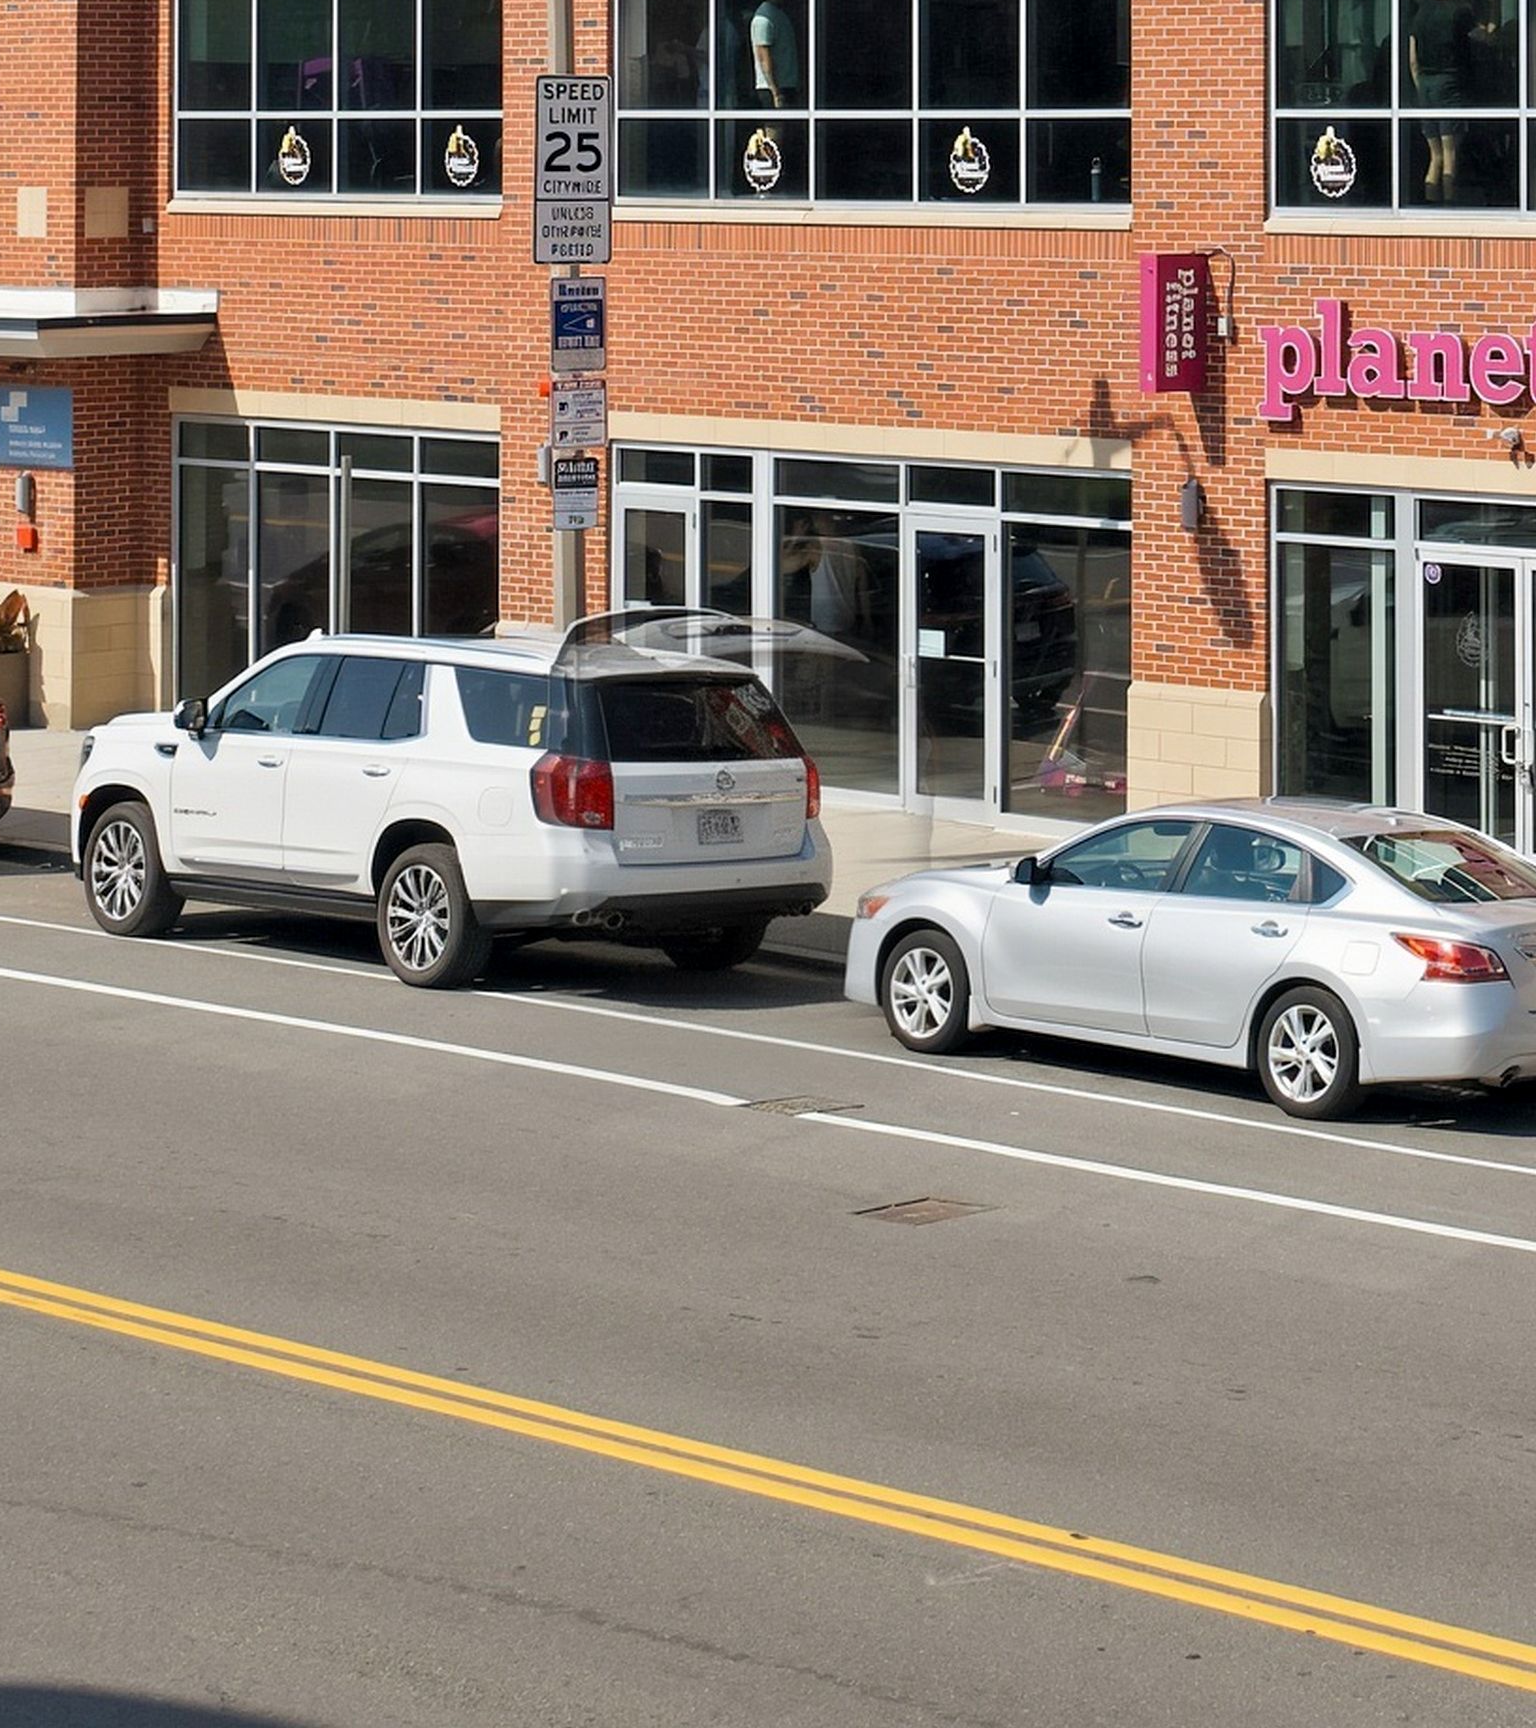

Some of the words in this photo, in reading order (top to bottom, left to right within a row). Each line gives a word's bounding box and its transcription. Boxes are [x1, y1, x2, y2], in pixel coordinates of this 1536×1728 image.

[543, 83, 605, 101] SPEED
[548, 107, 598, 124] LIMIT
[543, 131, 603, 173] 25
[543, 180, 602, 194] CITYWIDE
[1178, 269, 1199, 359] planet
[1165, 281, 1182, 378] fitness
